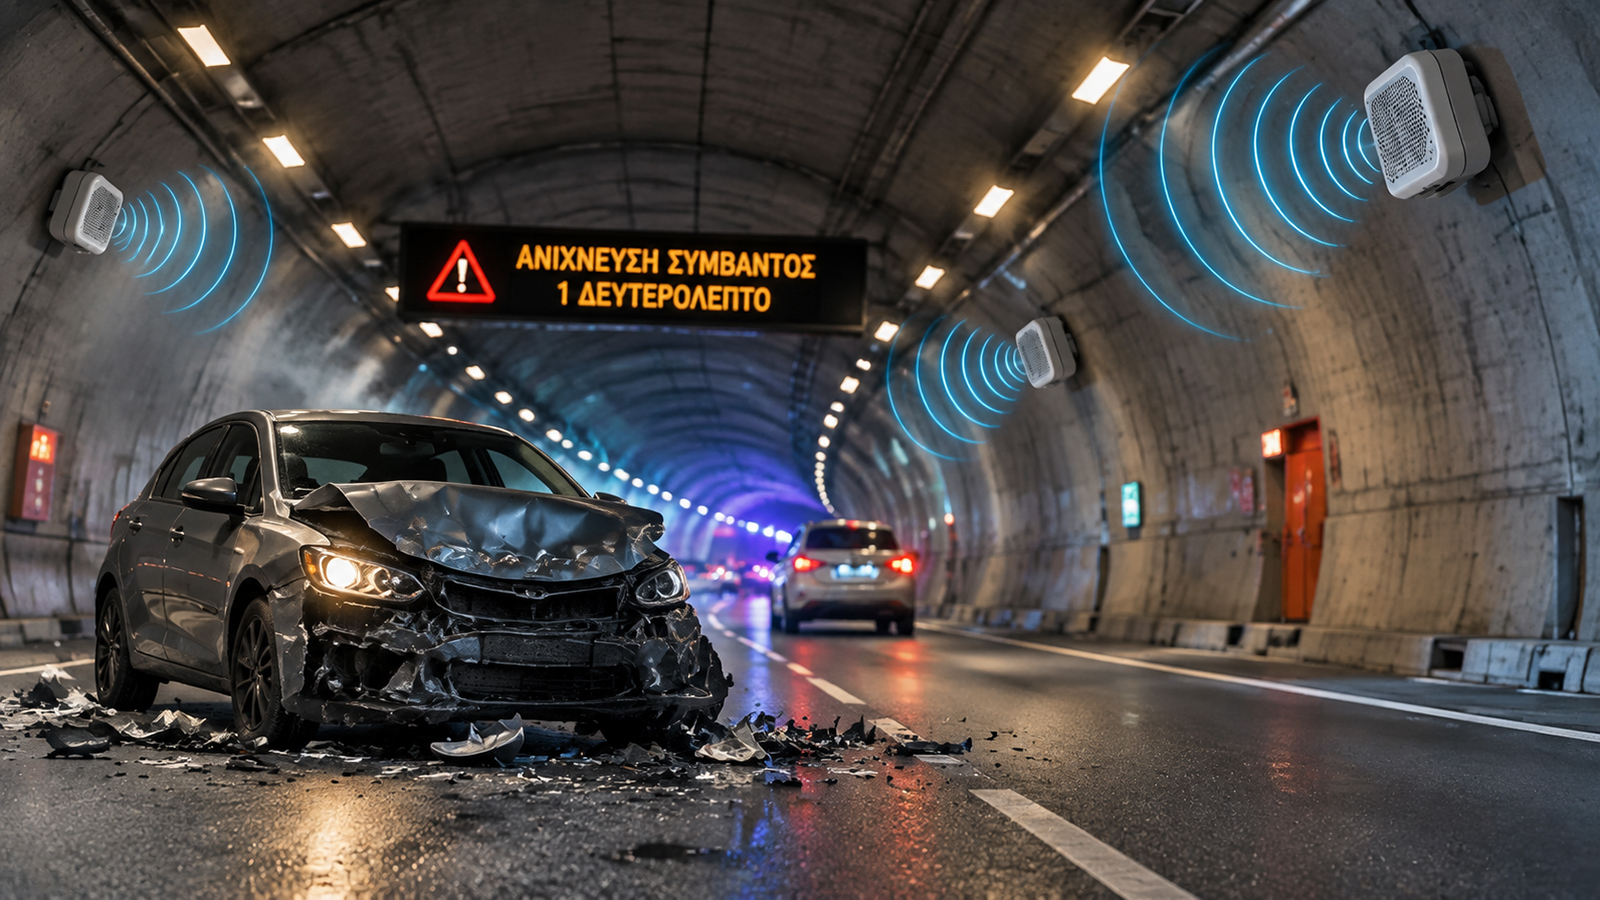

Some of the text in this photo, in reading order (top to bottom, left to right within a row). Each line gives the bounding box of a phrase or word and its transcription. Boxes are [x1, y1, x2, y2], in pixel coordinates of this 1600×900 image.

[515, 244, 816, 279] ΑΝΙΧΝΕΥΣΗ ΣΥΜΒΑΝΤΟΣ
[557, 280, 771, 312] 1 ΔΕΥΤΕΡΟΛΕΠΤΟ
